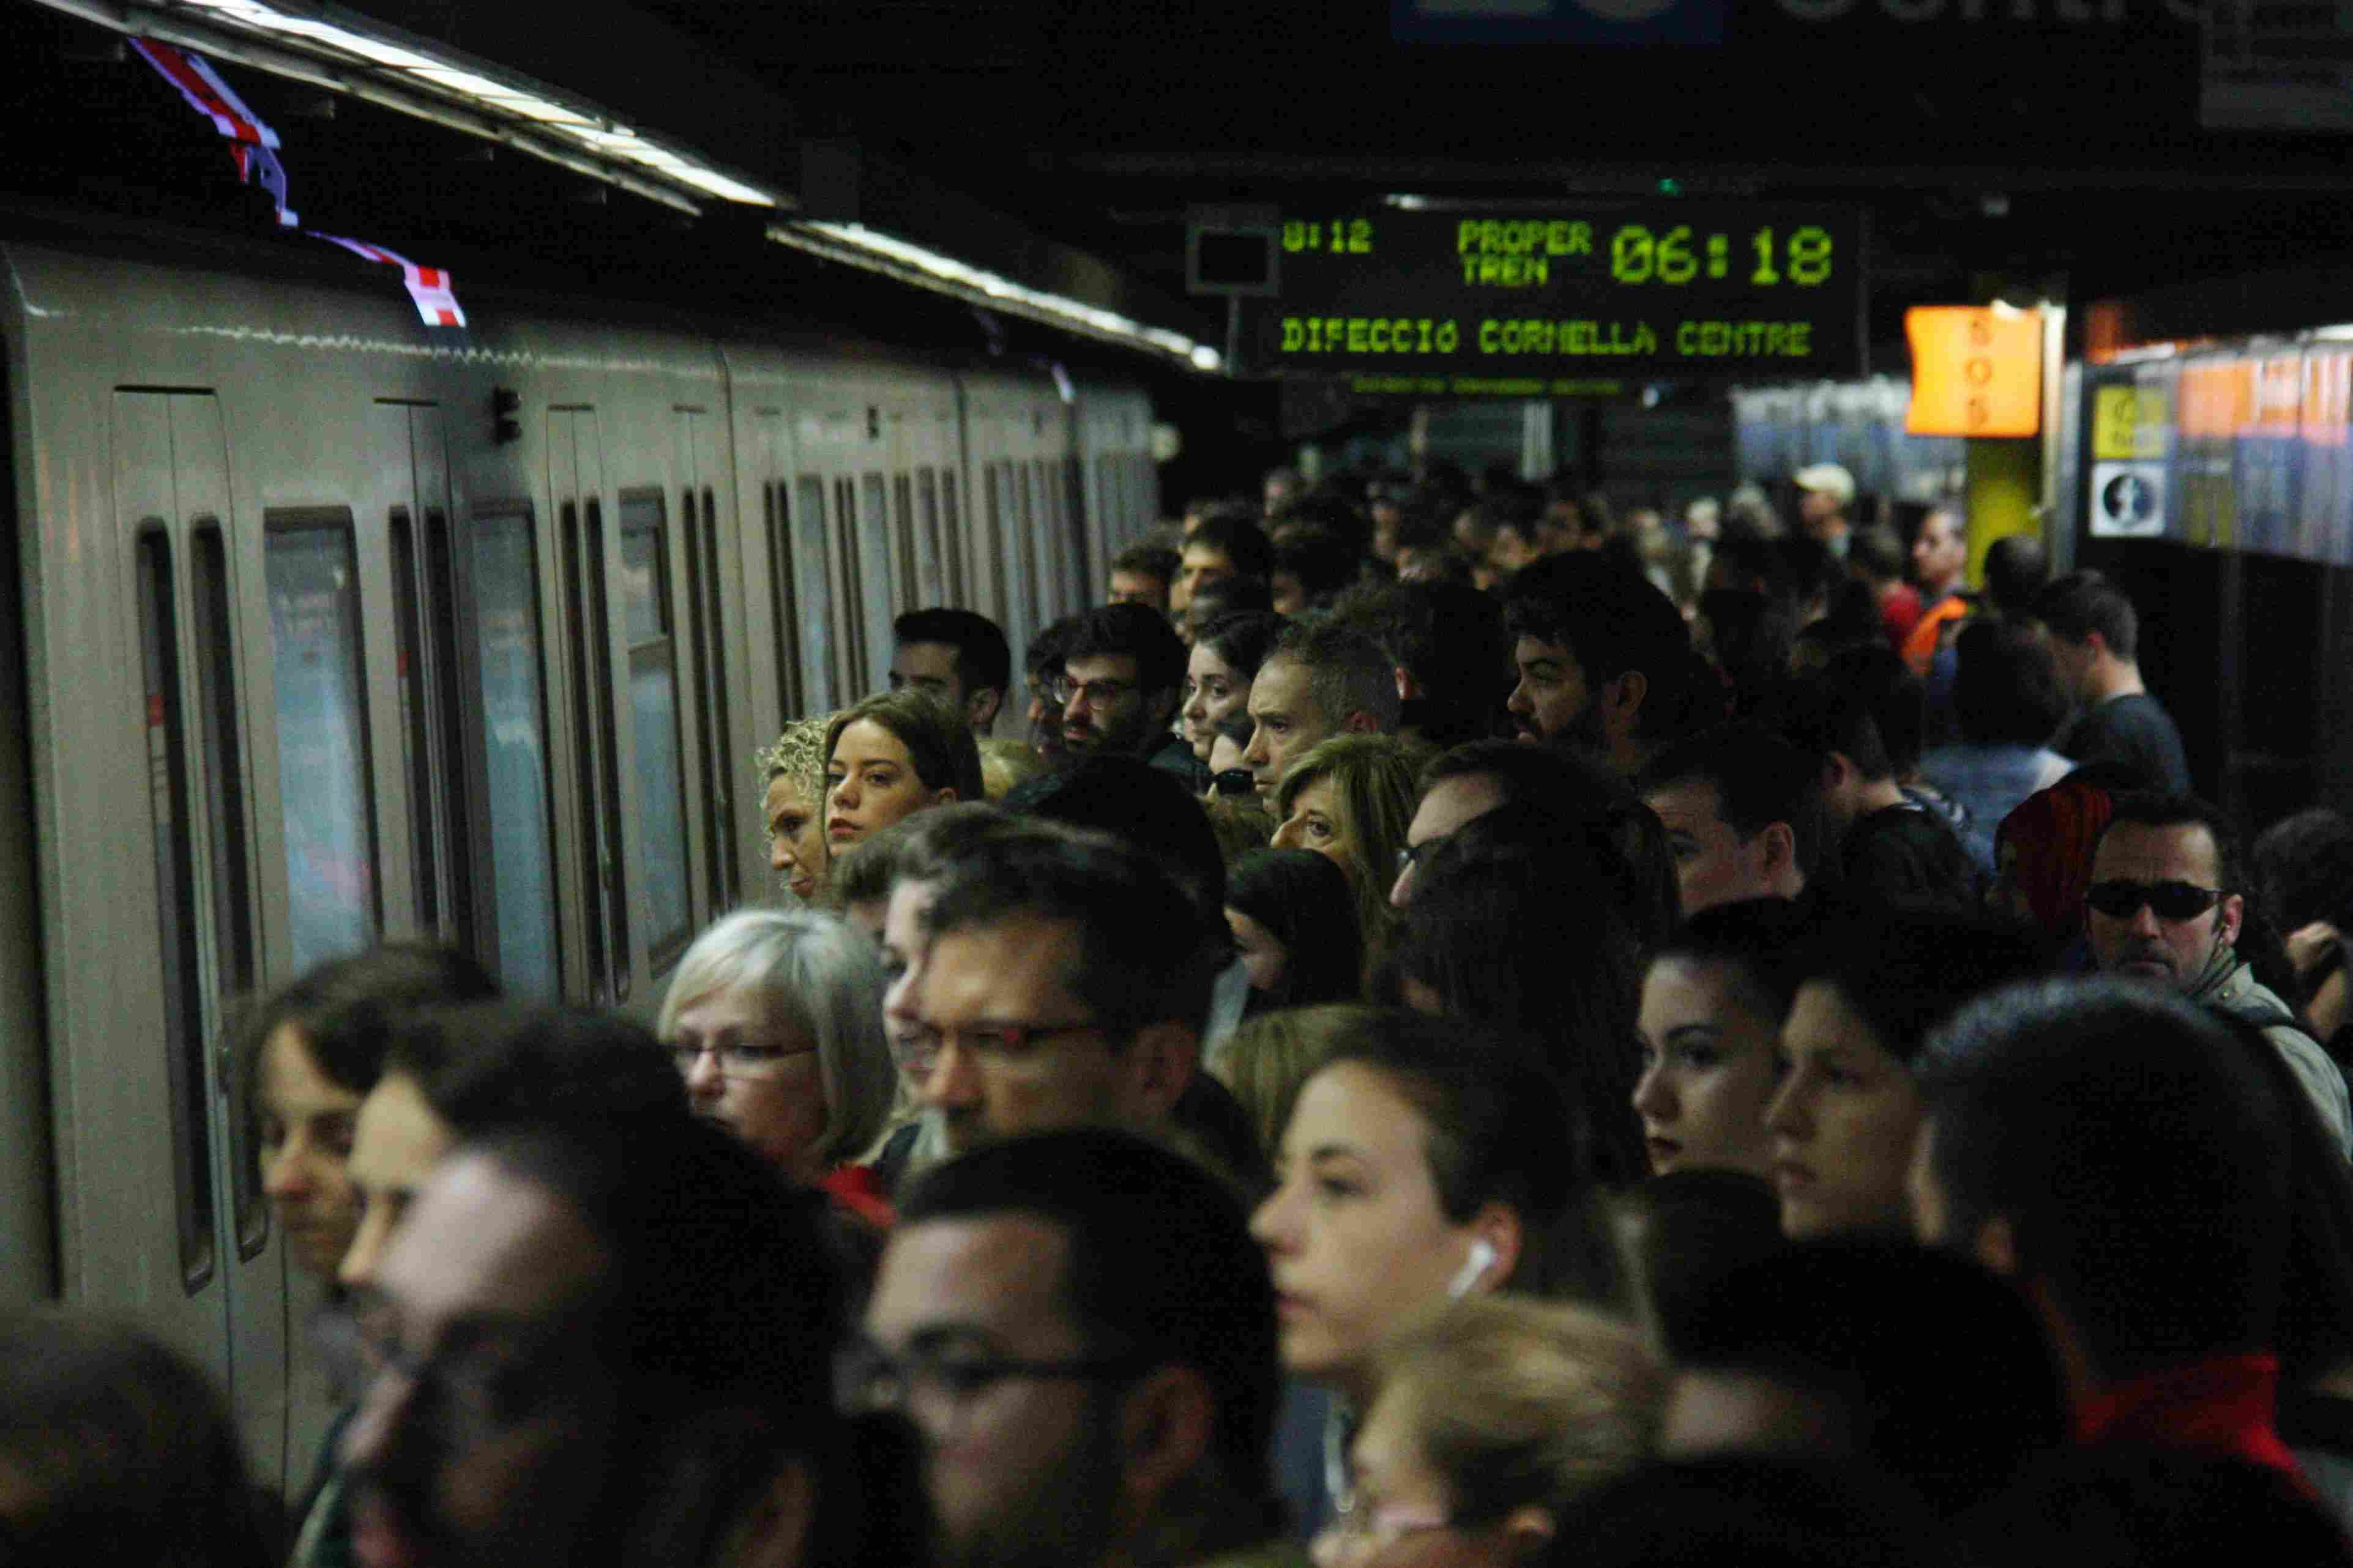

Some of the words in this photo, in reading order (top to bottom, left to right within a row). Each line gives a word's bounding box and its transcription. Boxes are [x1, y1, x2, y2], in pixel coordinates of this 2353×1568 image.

[1457, 219, 1593, 255] PROPER
[1462, 255, 1548, 286] TREN
[1609, 225, 1832, 285] 06:18
[1677, 321, 1813, 356] CENTRE
